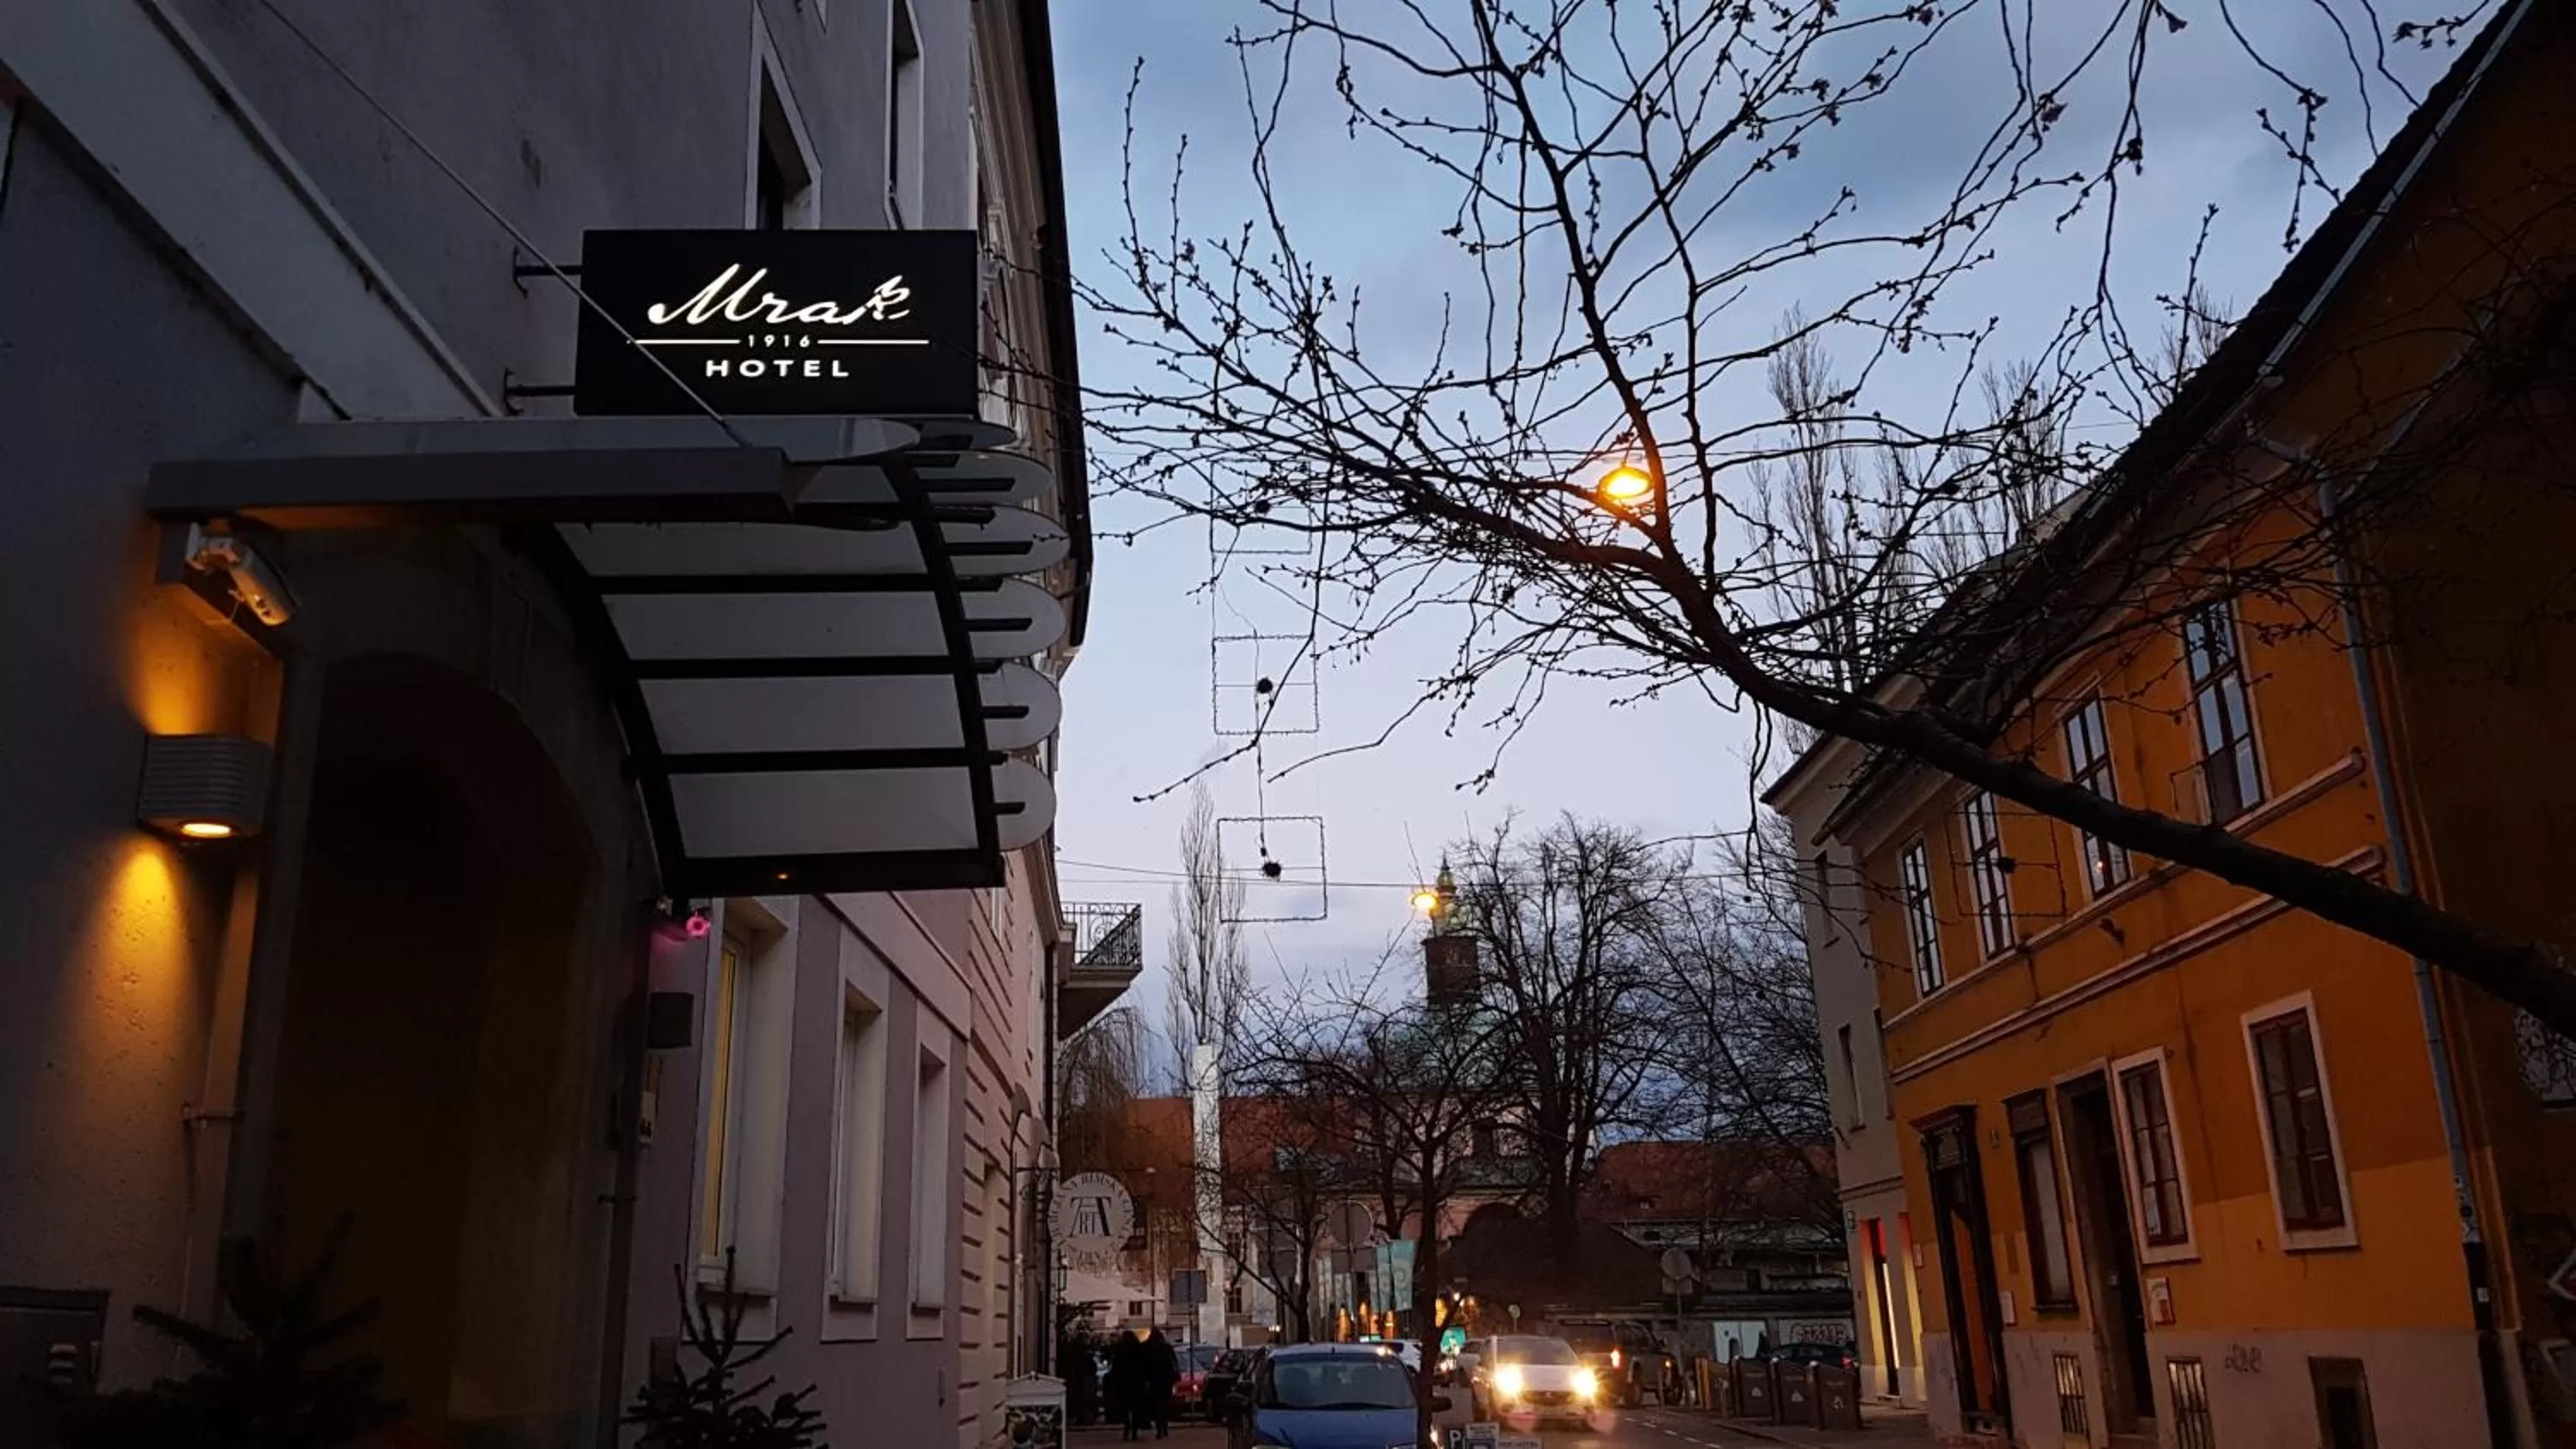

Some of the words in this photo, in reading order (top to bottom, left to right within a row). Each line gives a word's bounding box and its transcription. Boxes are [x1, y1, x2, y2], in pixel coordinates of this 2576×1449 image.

[647, 263, 910, 325] Mrak
[748, 334, 811, 348] 1916
[706, 359, 849, 378] HOTEL
[1449, 1429, 1461, 1449] P
